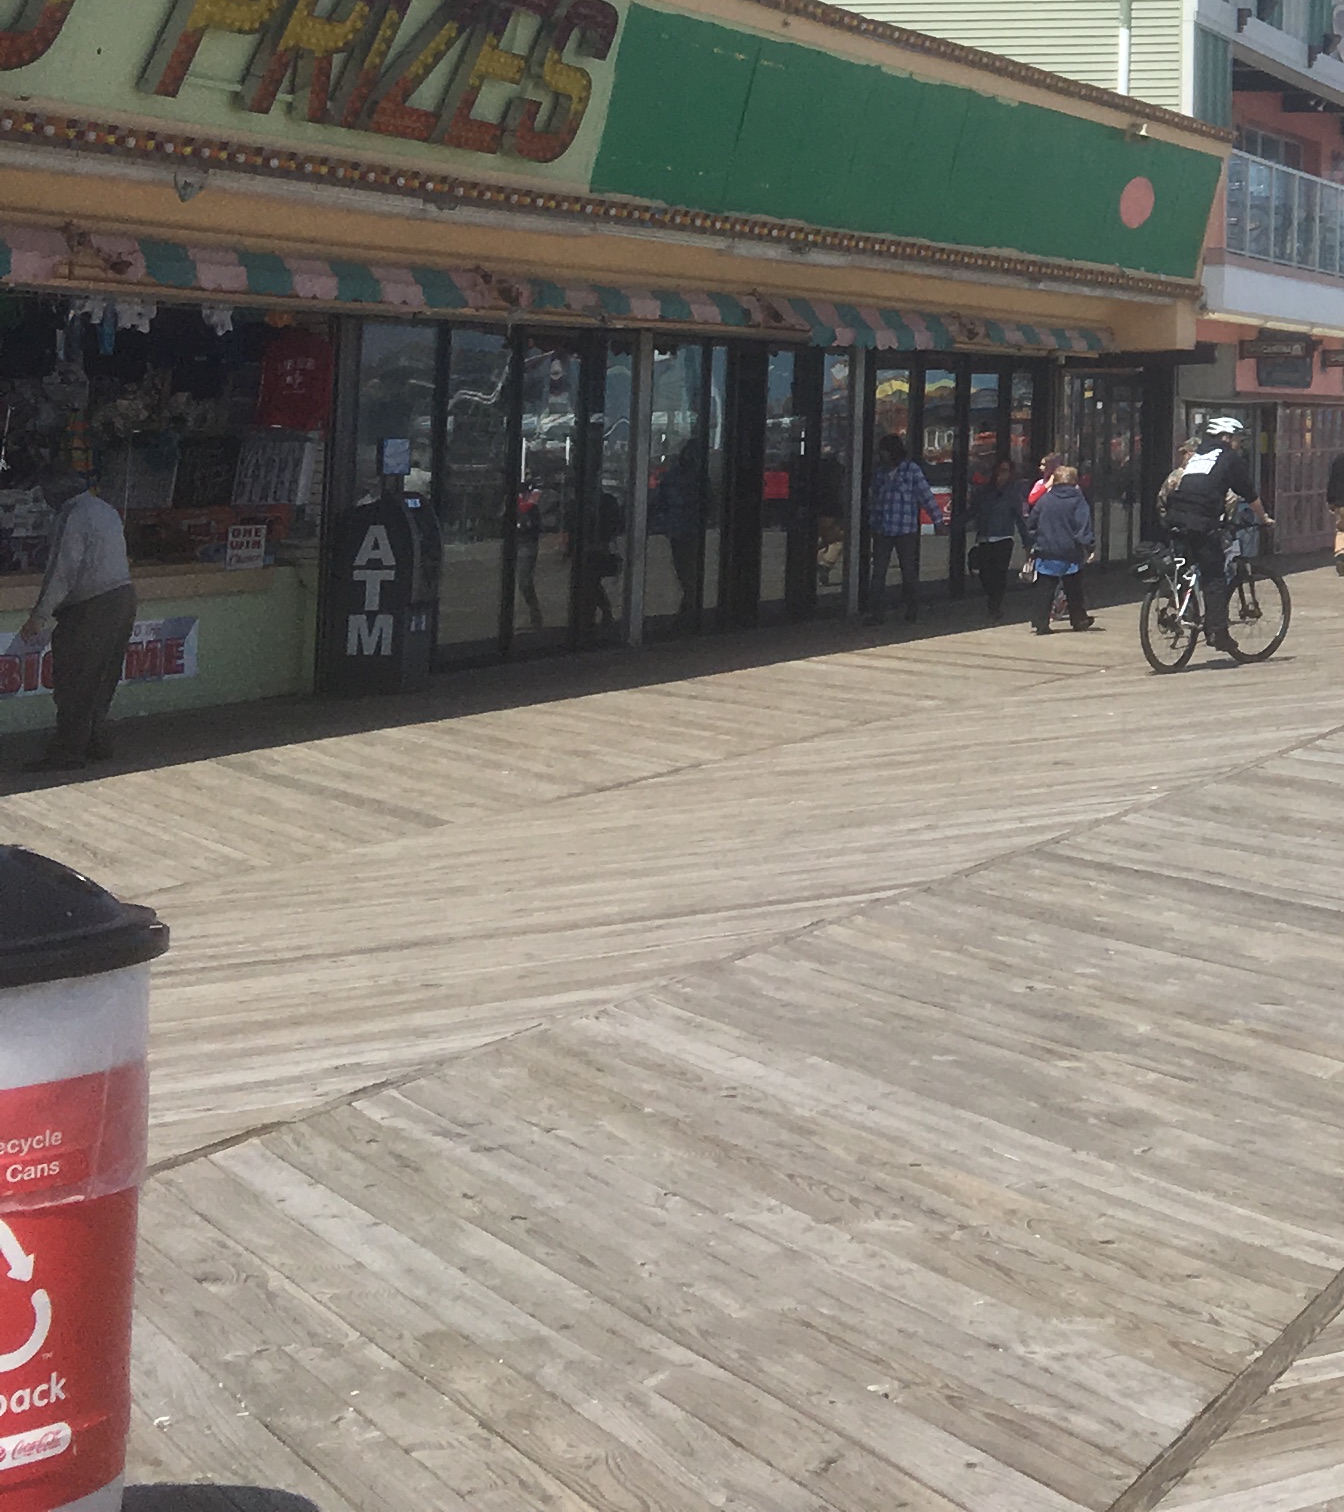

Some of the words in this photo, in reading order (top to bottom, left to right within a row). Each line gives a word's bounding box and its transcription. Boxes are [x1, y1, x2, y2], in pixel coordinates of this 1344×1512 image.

[346, 524, 397, 656] ATM
[0, 1129, 62, 1156] ecycle
[5, 1160, 60, 1182] Cans
